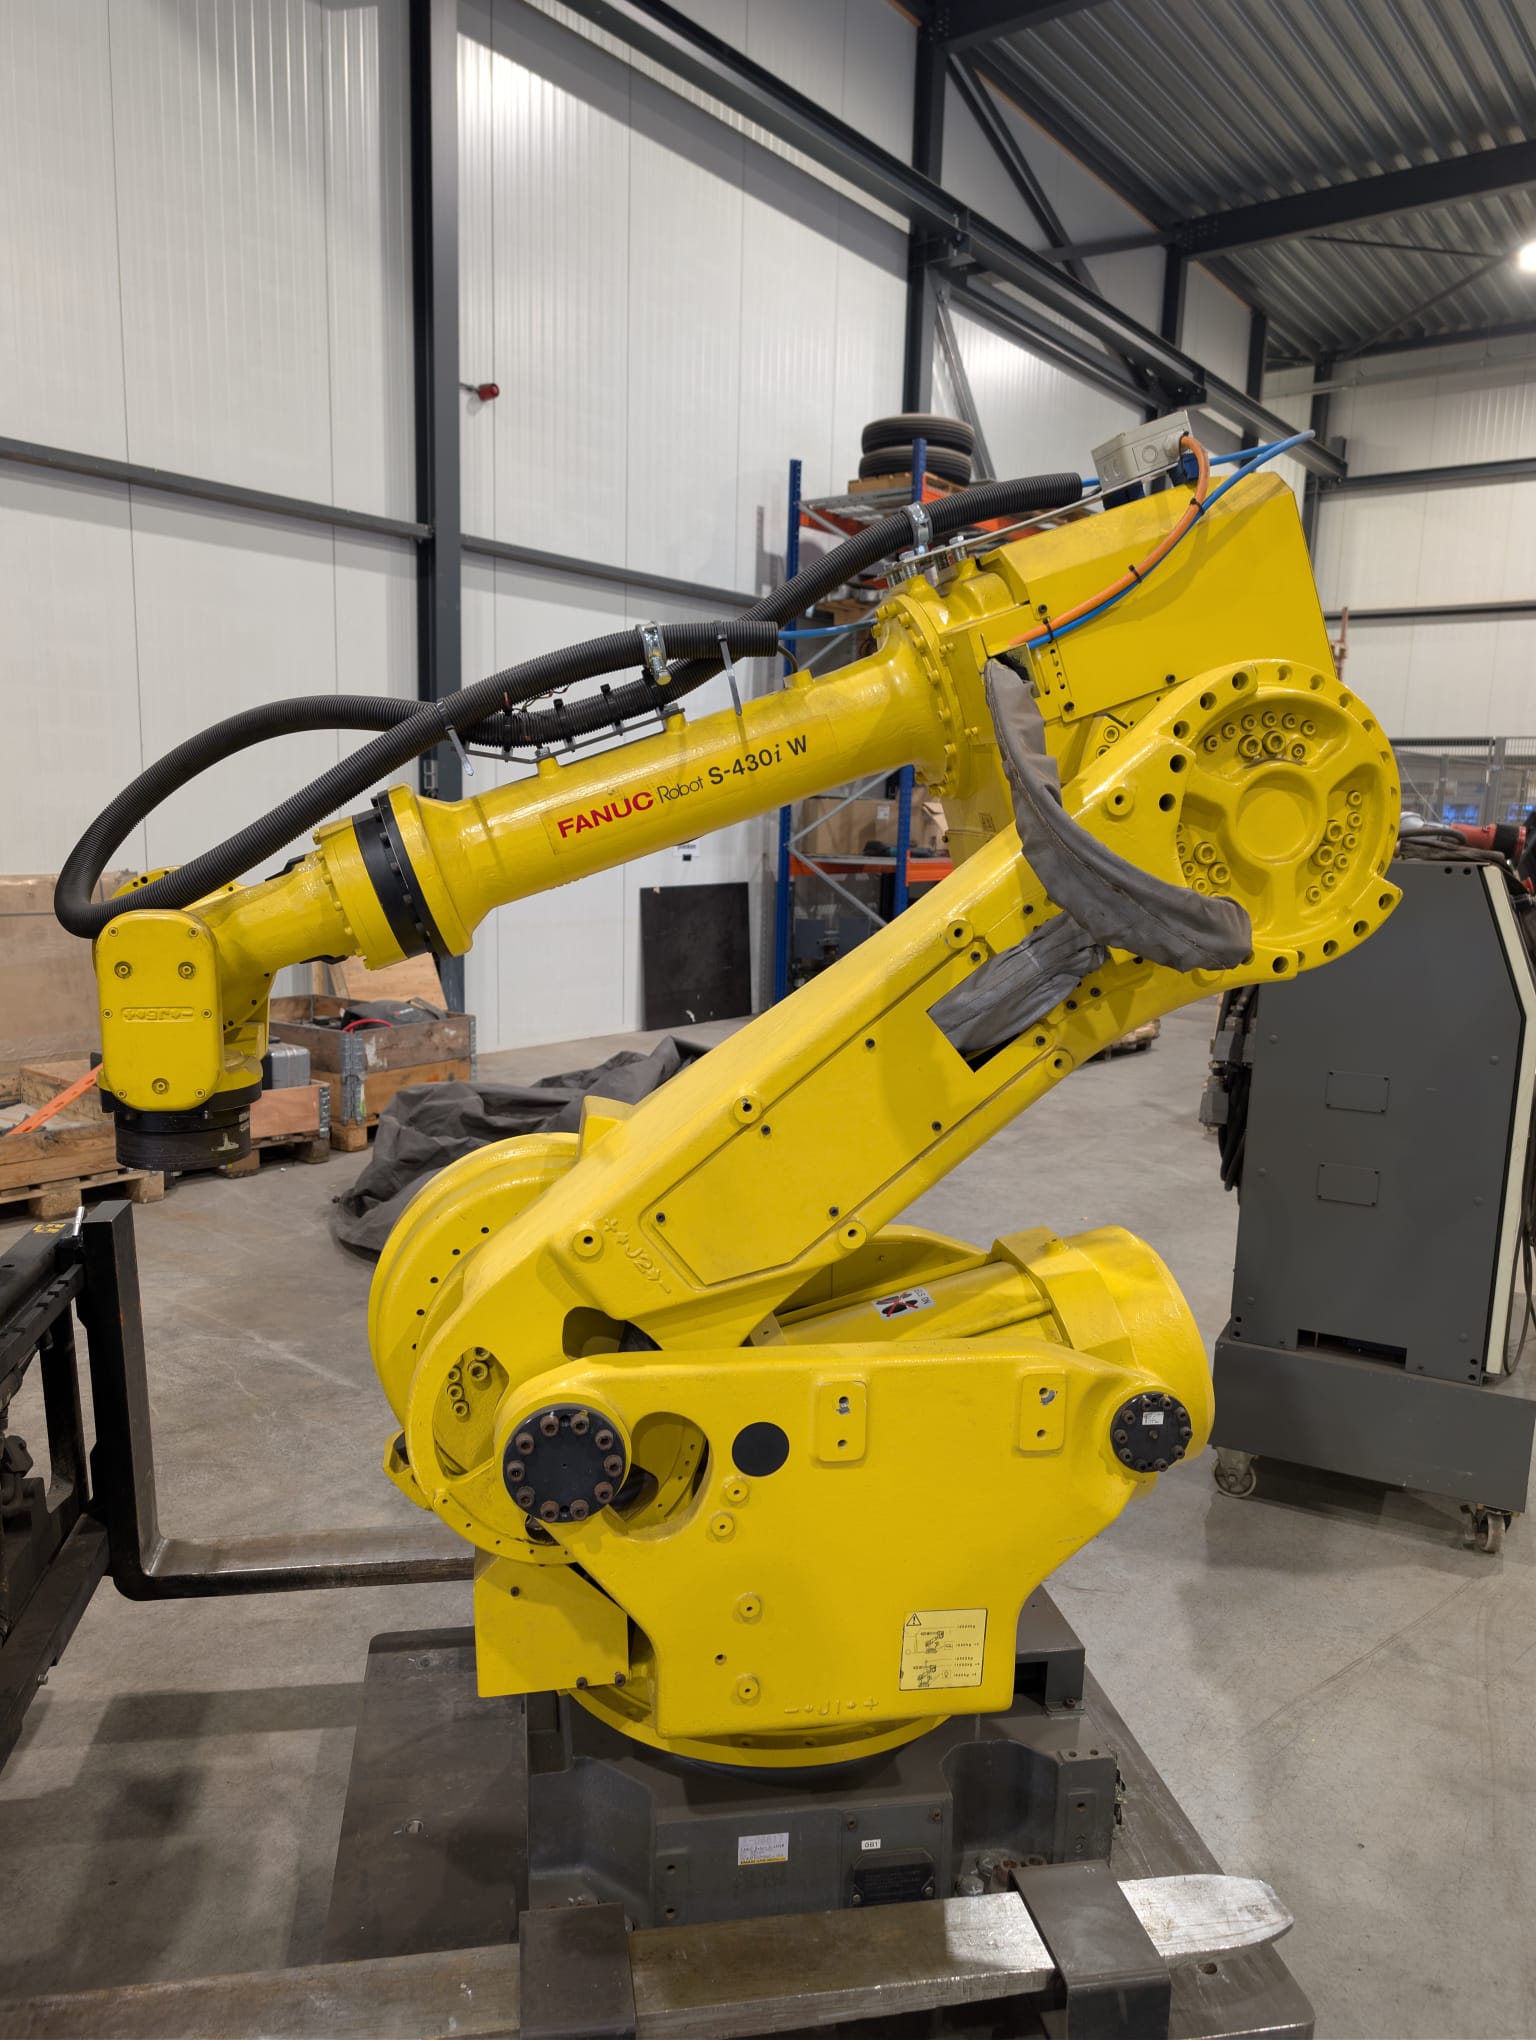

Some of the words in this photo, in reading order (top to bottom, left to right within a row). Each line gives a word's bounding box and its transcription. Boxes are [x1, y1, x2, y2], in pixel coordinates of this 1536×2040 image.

[557, 791, 654, 838] FANUC
[656, 775, 704, 804] Robot
[708, 743, 783, 785] S-430i
[786, 735, 808, 756] W
